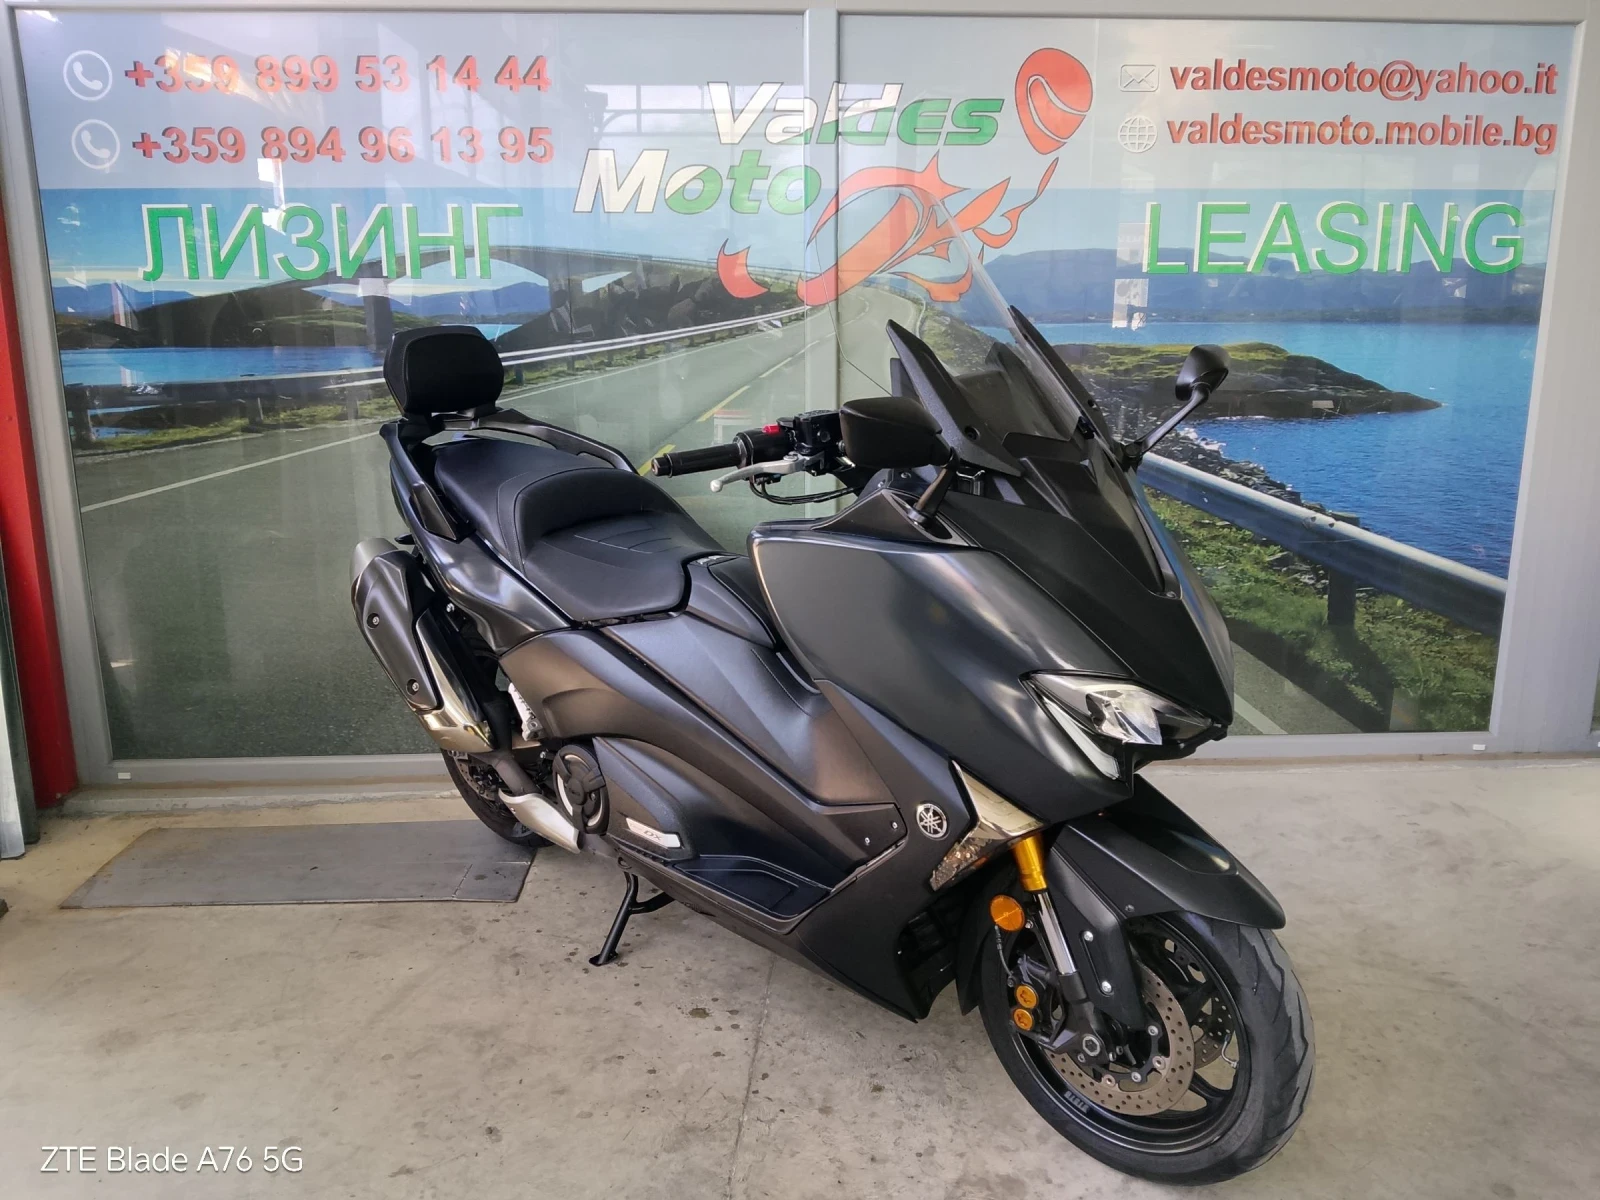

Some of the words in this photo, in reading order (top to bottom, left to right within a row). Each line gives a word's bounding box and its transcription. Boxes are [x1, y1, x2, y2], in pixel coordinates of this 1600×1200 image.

[124, 54, 239, 93] +359
[255, 54, 339, 93] 899
[354, 55, 409, 93] 53
[427, 55, 481, 92] 14
[495, 55, 551, 92] 44
[1169, 58, 1559, 101] valdesmoto@yahoo.it
[706, 81, 1004, 146] Valdes
[1166, 113, 1557, 155] valdesmoto.mobile.bg
[132, 126, 246, 164] +359
[260, 126, 346, 164] 894
[359, 127, 415, 163] 96
[431, 127, 484, 163] 13
[499, 127, 555, 164] 95
[573, 148, 821, 215] Moto
[138, 203, 523, 282] ЛИЗИНГ
[1142, 201, 1525, 275] LEASING
